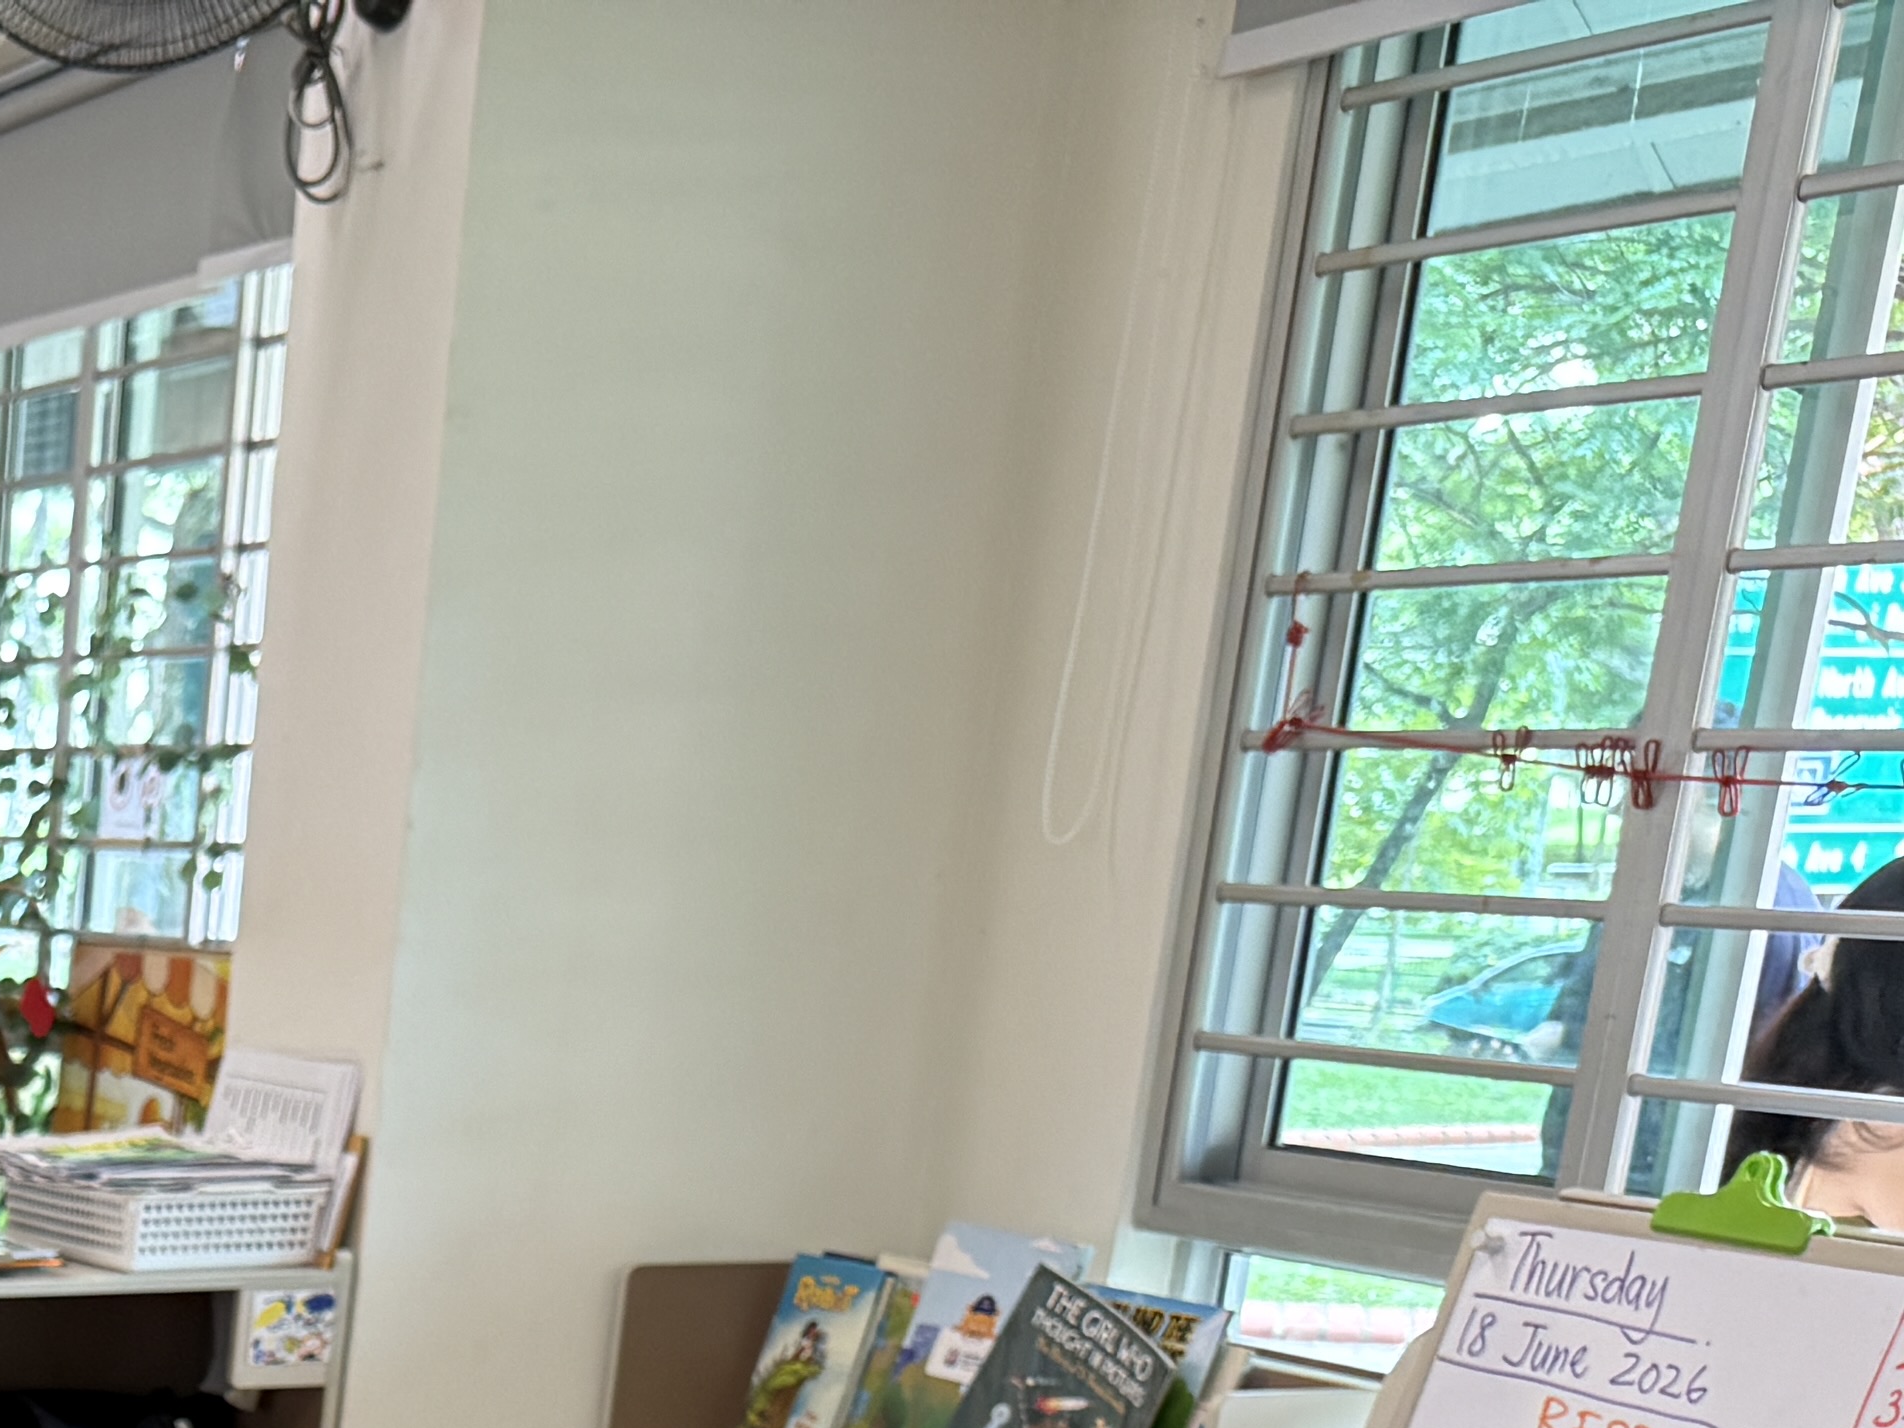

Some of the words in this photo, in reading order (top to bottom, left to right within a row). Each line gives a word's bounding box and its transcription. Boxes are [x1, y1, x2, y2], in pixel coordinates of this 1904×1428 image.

[1045, 1284, 1087, 1325] THE
[1082, 1309, 1121, 1353] GIRL
[1117, 1336, 1154, 1382] WHO
[1509, 1231, 1670, 1345] Thursday
[1455, 1308, 1498, 1357] 18
[1502, 1321, 1590, 1378] June
[1609, 1351, 1710, 1405] 2026
